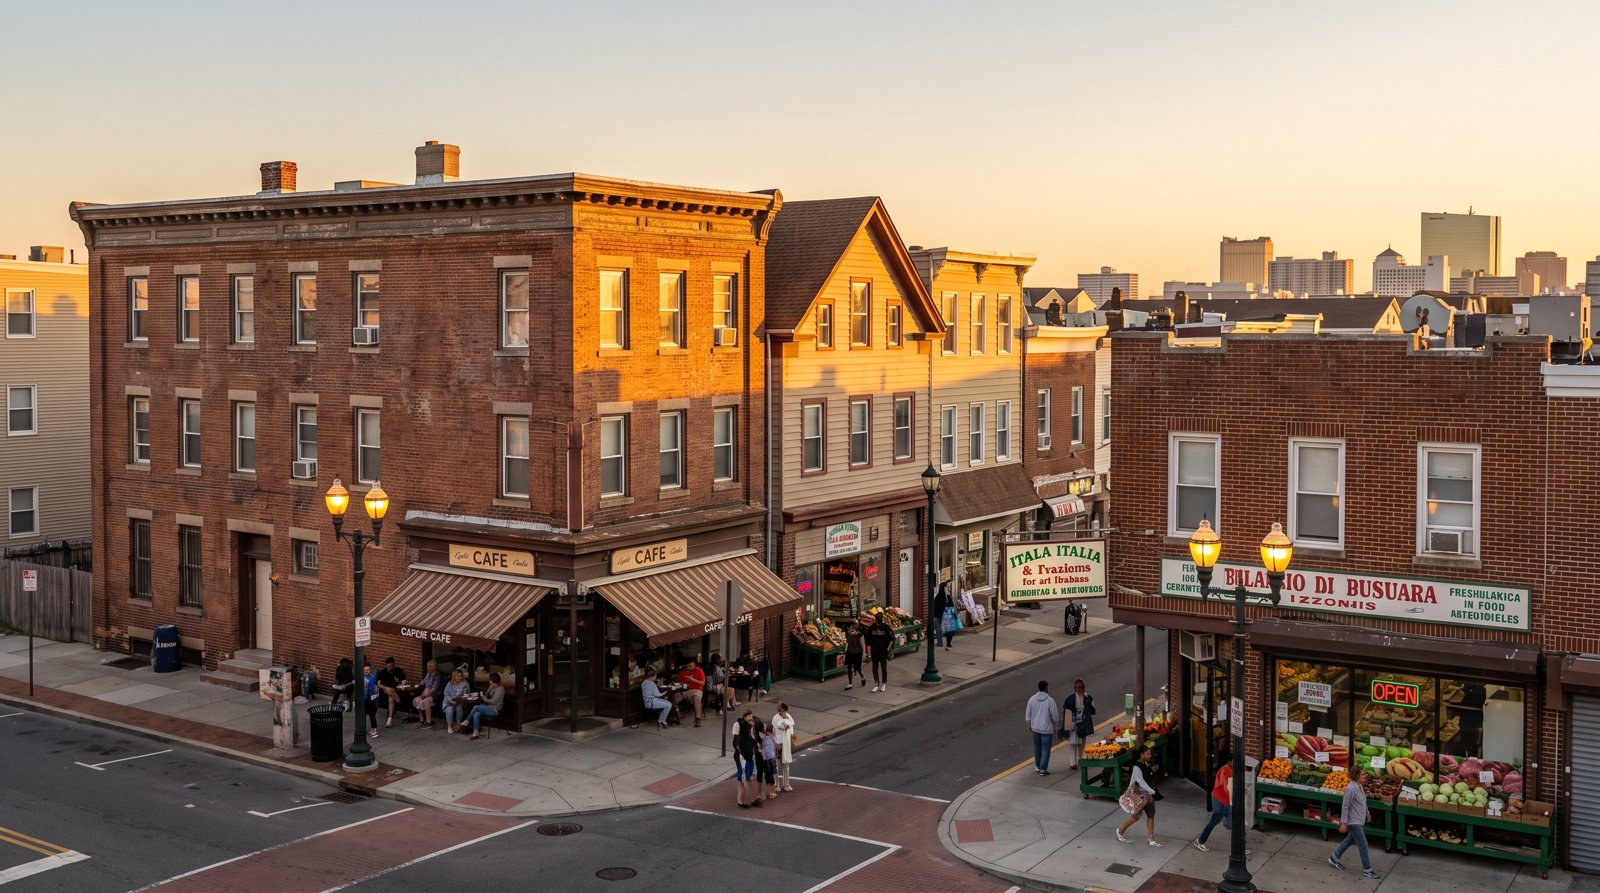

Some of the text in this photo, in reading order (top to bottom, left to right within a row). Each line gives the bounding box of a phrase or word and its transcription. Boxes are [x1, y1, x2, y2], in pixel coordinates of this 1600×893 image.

[473, 551, 508, 568] CAFE
[635, 546, 666, 565] CAFE
[1010, 545, 1101, 568] ITALA ITALIA
[1022, 565, 1032, 576] &
[1022, 578, 1036, 586] for
[1039, 576, 1051, 585] art
[1315, 575, 1334, 594] DI
[1346, 578, 1437, 604] BUSUARA
[1464, 600, 1505, 612] IN FOOD
[735, 612, 753, 624] CAFE
[430, 632, 451, 644] CAFE
[1373, 682, 1417, 705] OPEN
